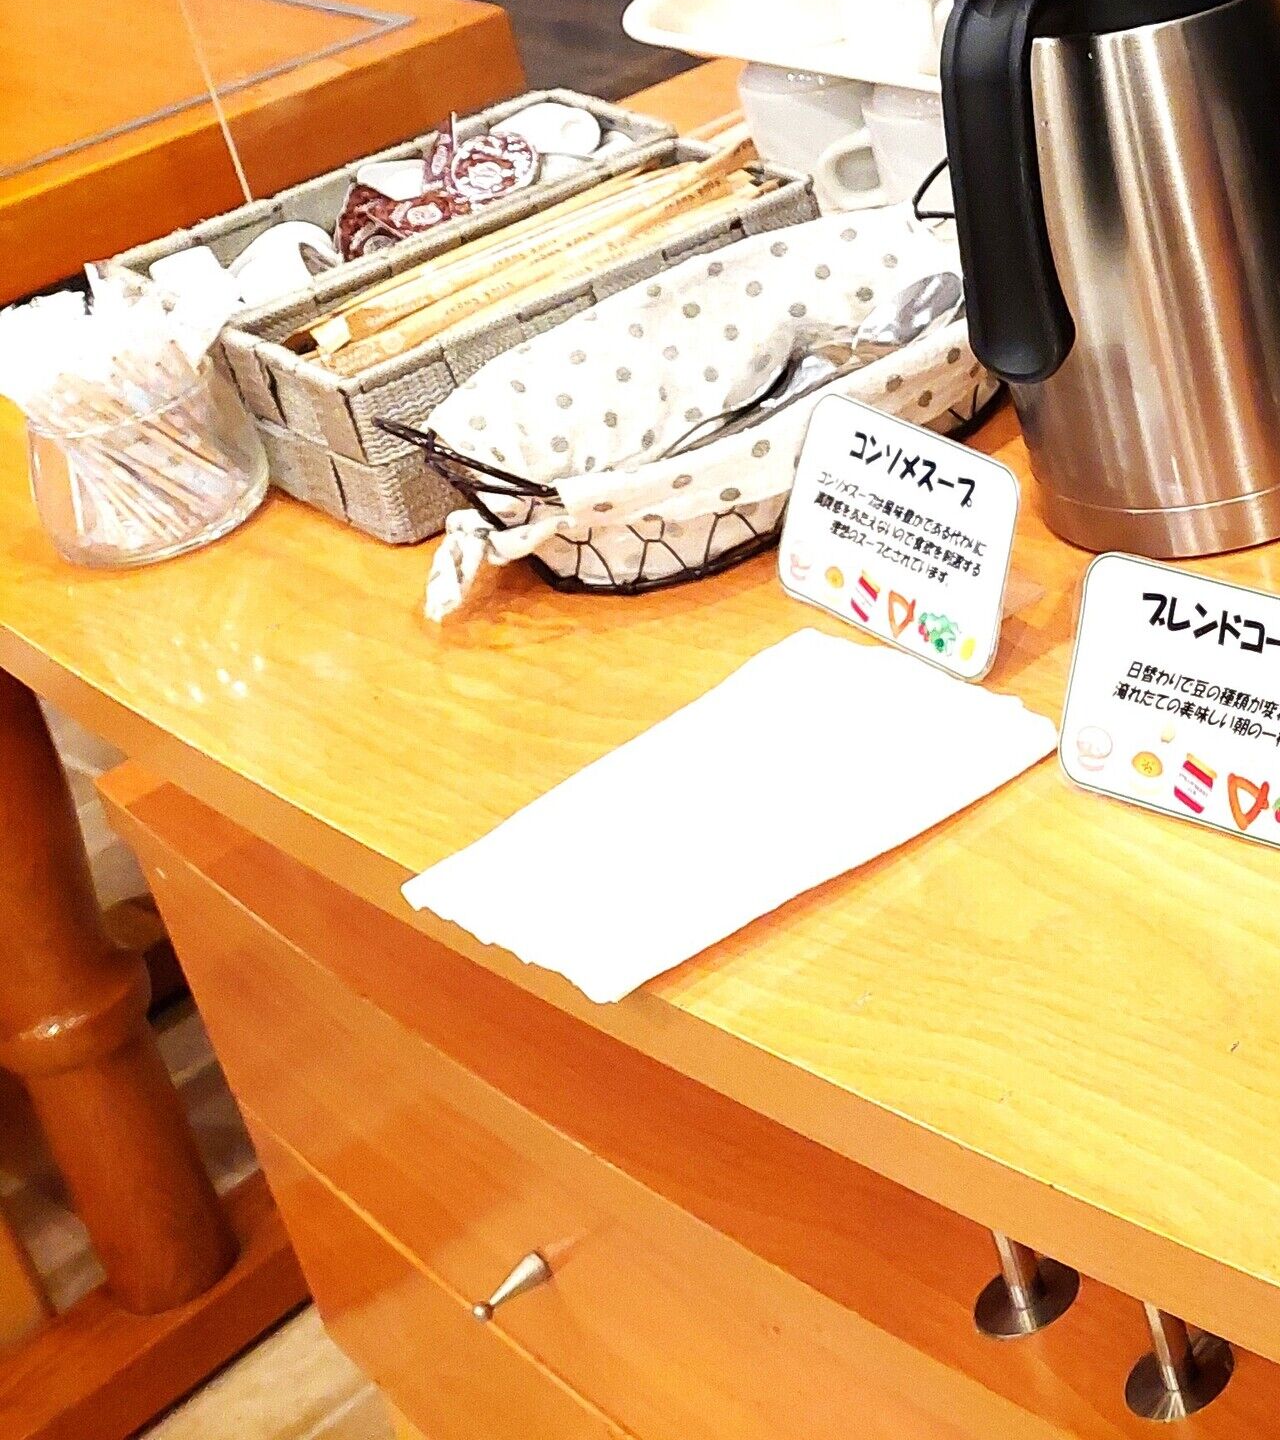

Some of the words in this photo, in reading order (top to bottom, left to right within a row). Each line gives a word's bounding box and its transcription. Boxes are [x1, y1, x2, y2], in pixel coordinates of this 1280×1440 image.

[849, 431, 976, 508] コンソメスープ
